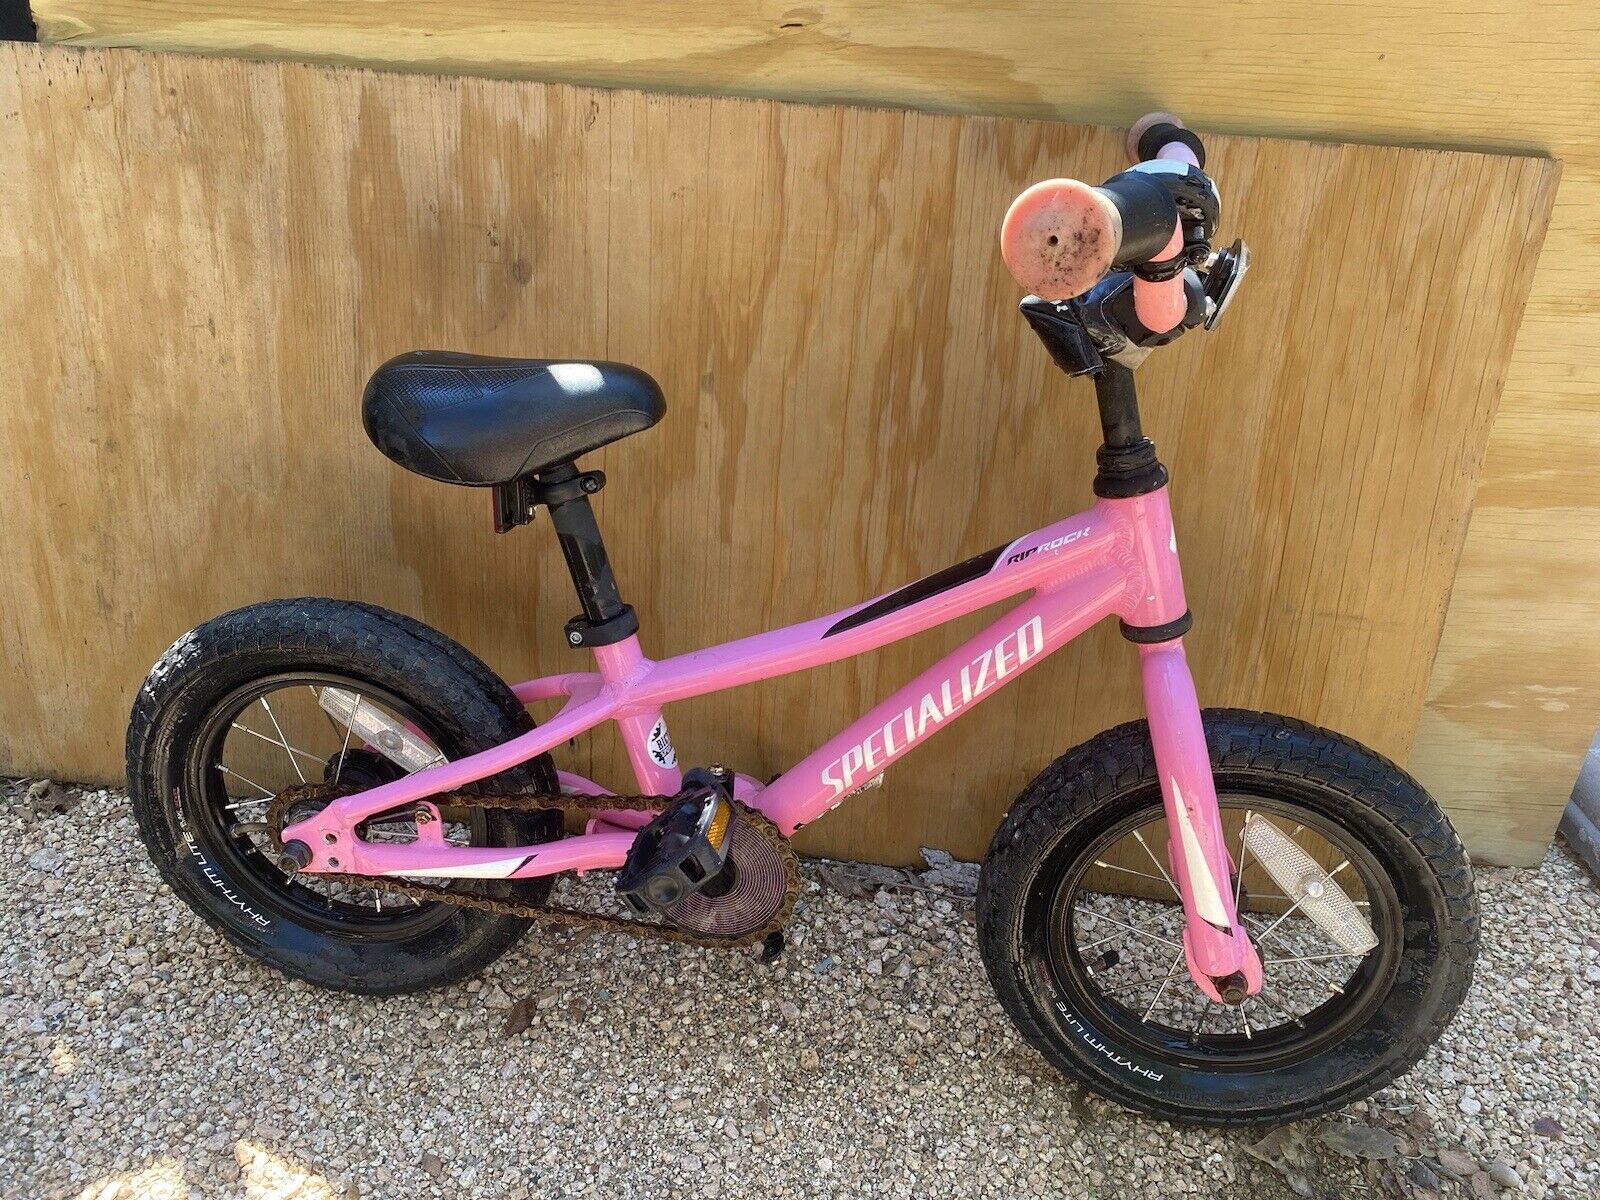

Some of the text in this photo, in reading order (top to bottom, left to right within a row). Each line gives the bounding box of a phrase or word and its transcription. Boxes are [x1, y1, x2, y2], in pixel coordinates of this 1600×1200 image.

[821, 614, 1044, 804] SPECIALIZED
[182, 830, 271, 927] RHYTHM LITE
[1055, 1000, 1164, 1082] RHYTHM LITE
